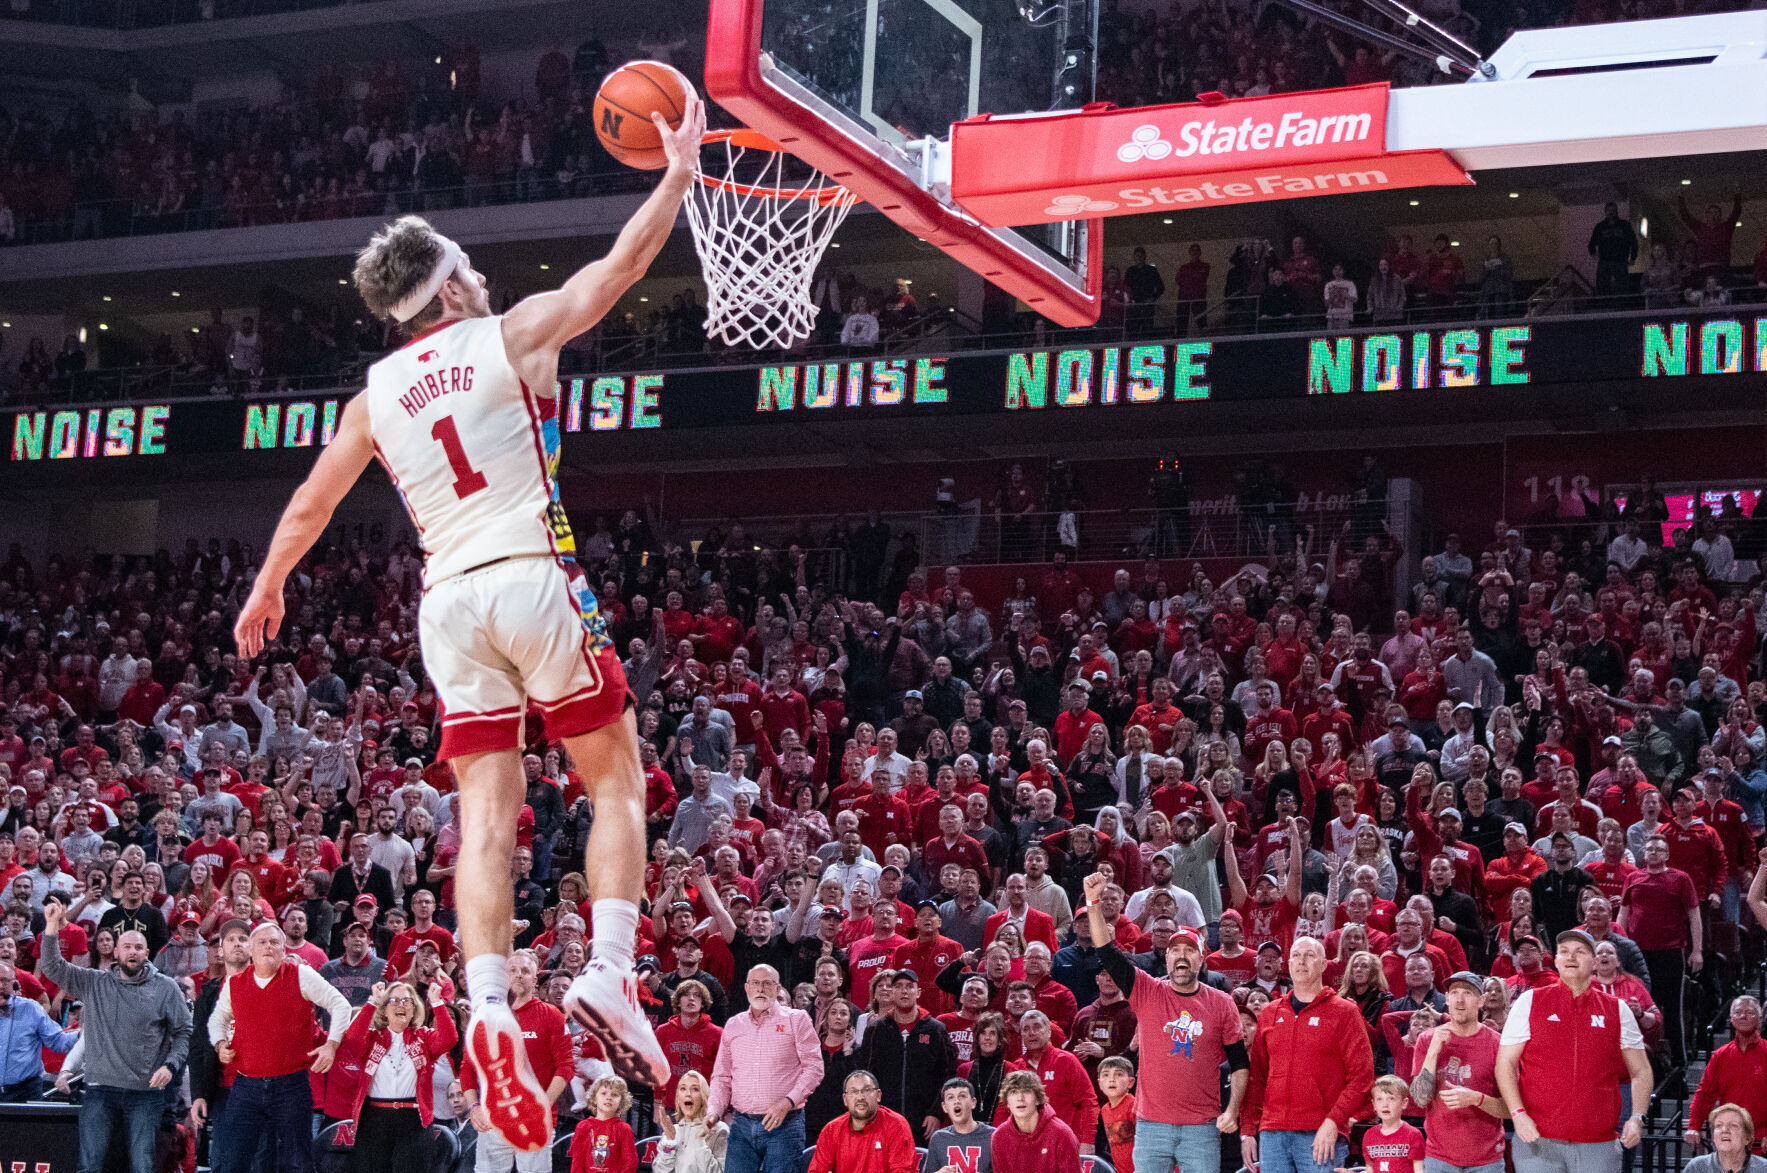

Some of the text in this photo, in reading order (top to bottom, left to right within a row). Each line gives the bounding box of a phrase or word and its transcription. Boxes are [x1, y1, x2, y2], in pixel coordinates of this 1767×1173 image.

[601, 106, 624, 139] N
[1641, 317, 1767, 376] NOI
[1307, 326, 1532, 395] NOISE
[1004, 342, 1212, 408] NOISE
[398, 366, 474, 418] HOIBERG
[566, 375, 665, 432] ISE
[11, 405, 170, 460] NOISE
[243, 400, 338, 450] NOI
[431, 414, 489, 500] 1
[1382, 827, 1404, 841] RASKA
[1252, 916, 1273, 936] N
[857, 955, 886, 969] PROUD
[776, 1024, 784, 1032] N
[1308, 1016, 1320, 1027] N
[1590, 1014, 1605, 1029] N
[950, 1029, 974, 1042] EBRA
[1172, 1028, 1188, 1044] N
[1044, 1070, 1055, 1081] N
[947, 1145, 982, 1173] N
[1379, 1161, 1389, 1172] N
